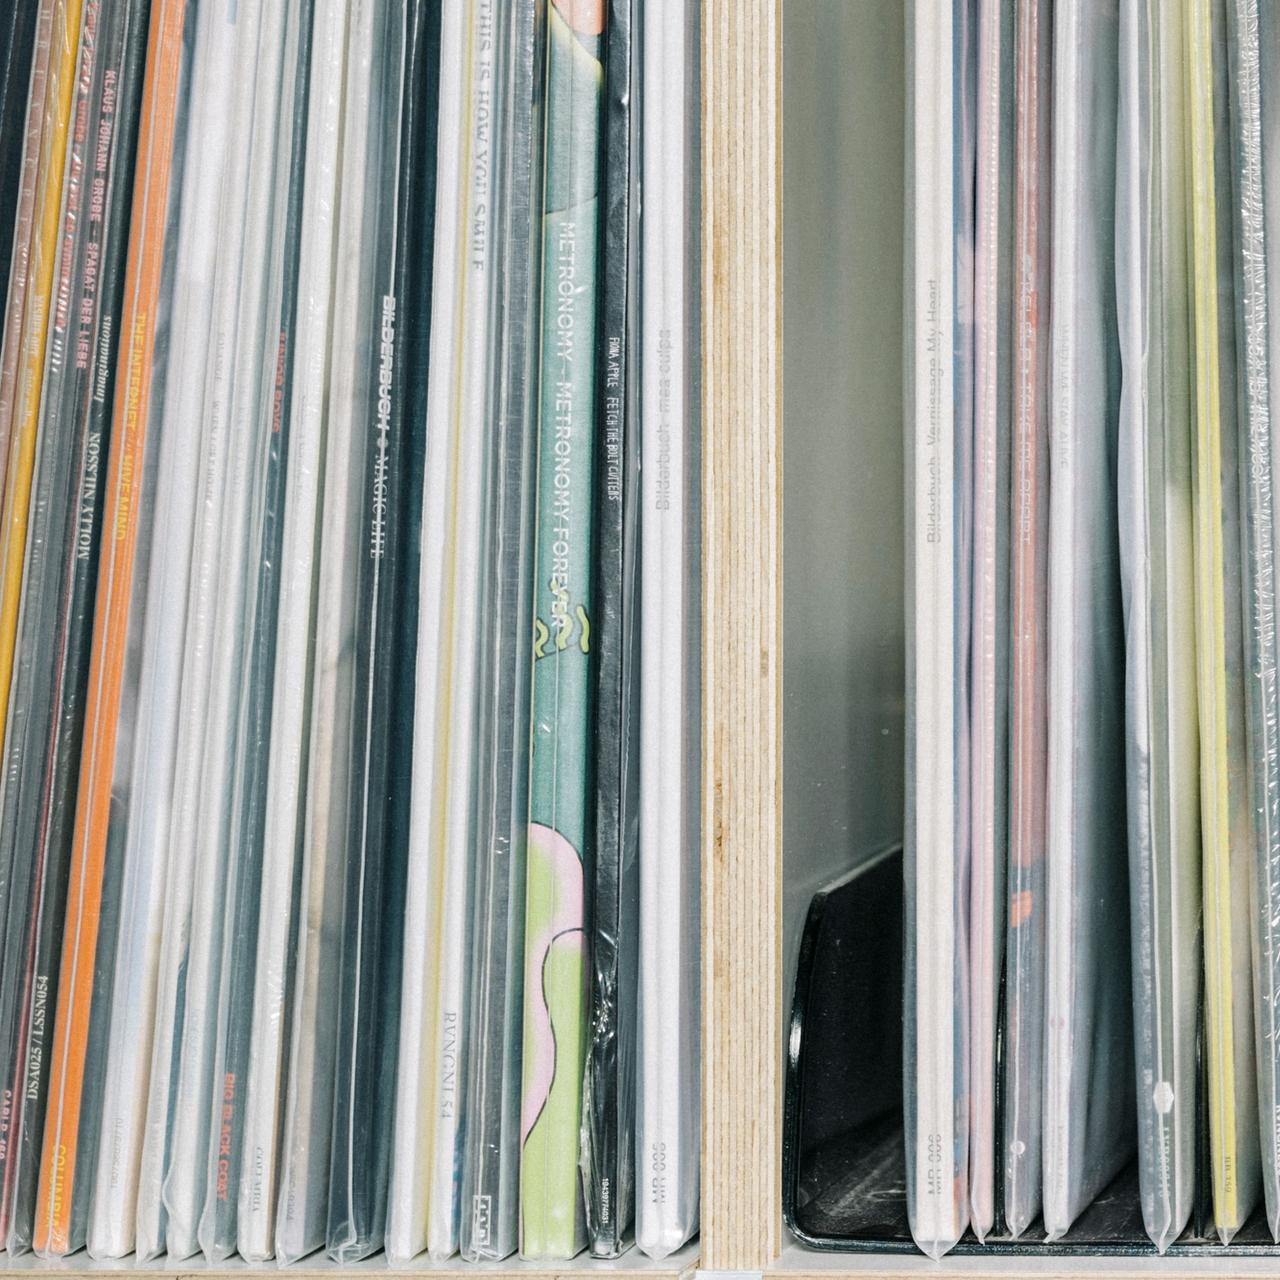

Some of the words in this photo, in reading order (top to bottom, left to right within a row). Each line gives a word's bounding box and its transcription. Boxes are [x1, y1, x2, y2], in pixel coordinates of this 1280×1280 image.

[100, 69, 115, 113] KLAUS
[95, 119, 112, 172] JOHANN
[90, 178, 107, 222] GROBE
[82, 242, 99, 292] SPAGAT
[555, 220, 577, 360] METRONOMY
[80, 298, 94, 324] DER
[76, 330, 91, 369] LIEBE
[90, 315, 112, 403] Imaginations
[552, 380, 574, 521] METRONOMY
[605, 427, 620, 444] THE
[80, 432, 100, 500] NILSSON
[75, 502, 94, 561] MOLLY
[549, 526, 571, 627] FOREVER
[30, 975, 50, 1037] LSSN054
[24, 1046, 43, 1101] DSA025
